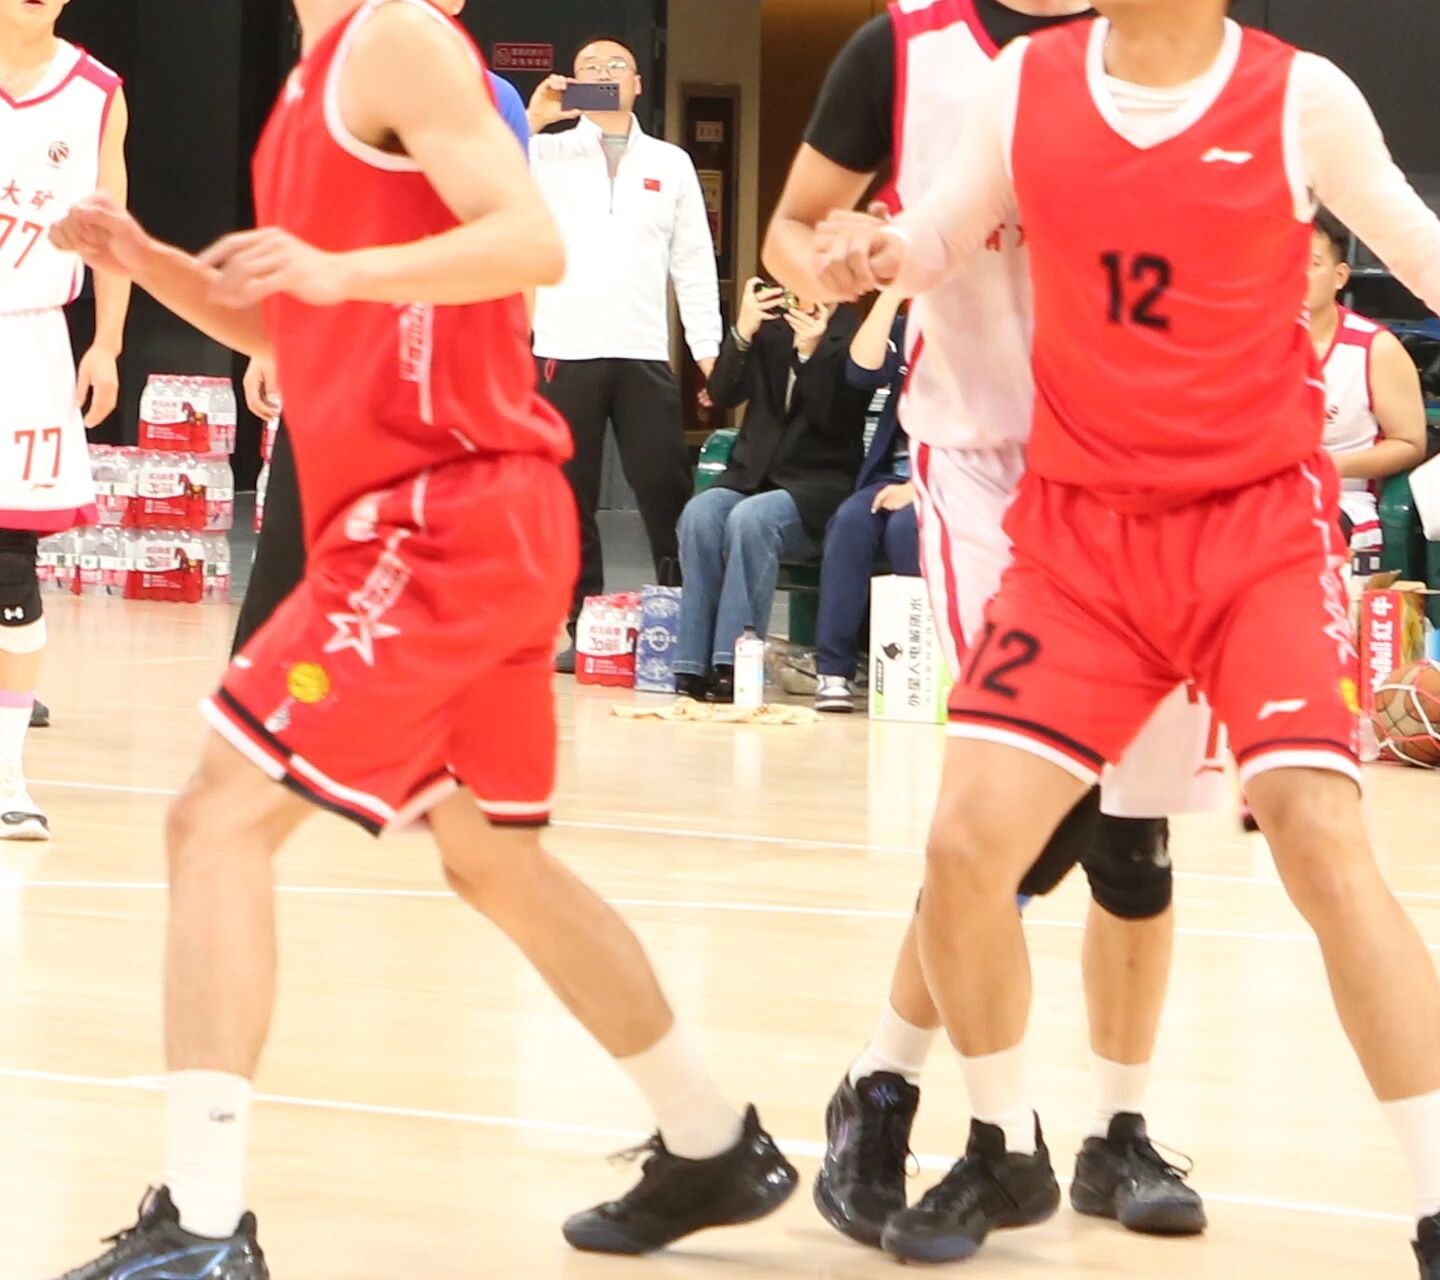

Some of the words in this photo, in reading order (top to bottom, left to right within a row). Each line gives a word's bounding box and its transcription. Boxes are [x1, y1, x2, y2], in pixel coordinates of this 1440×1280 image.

[1101, 250, 1172, 333] 12
[14, 426, 62, 481] 77
[967, 622, 1041, 701] 12
